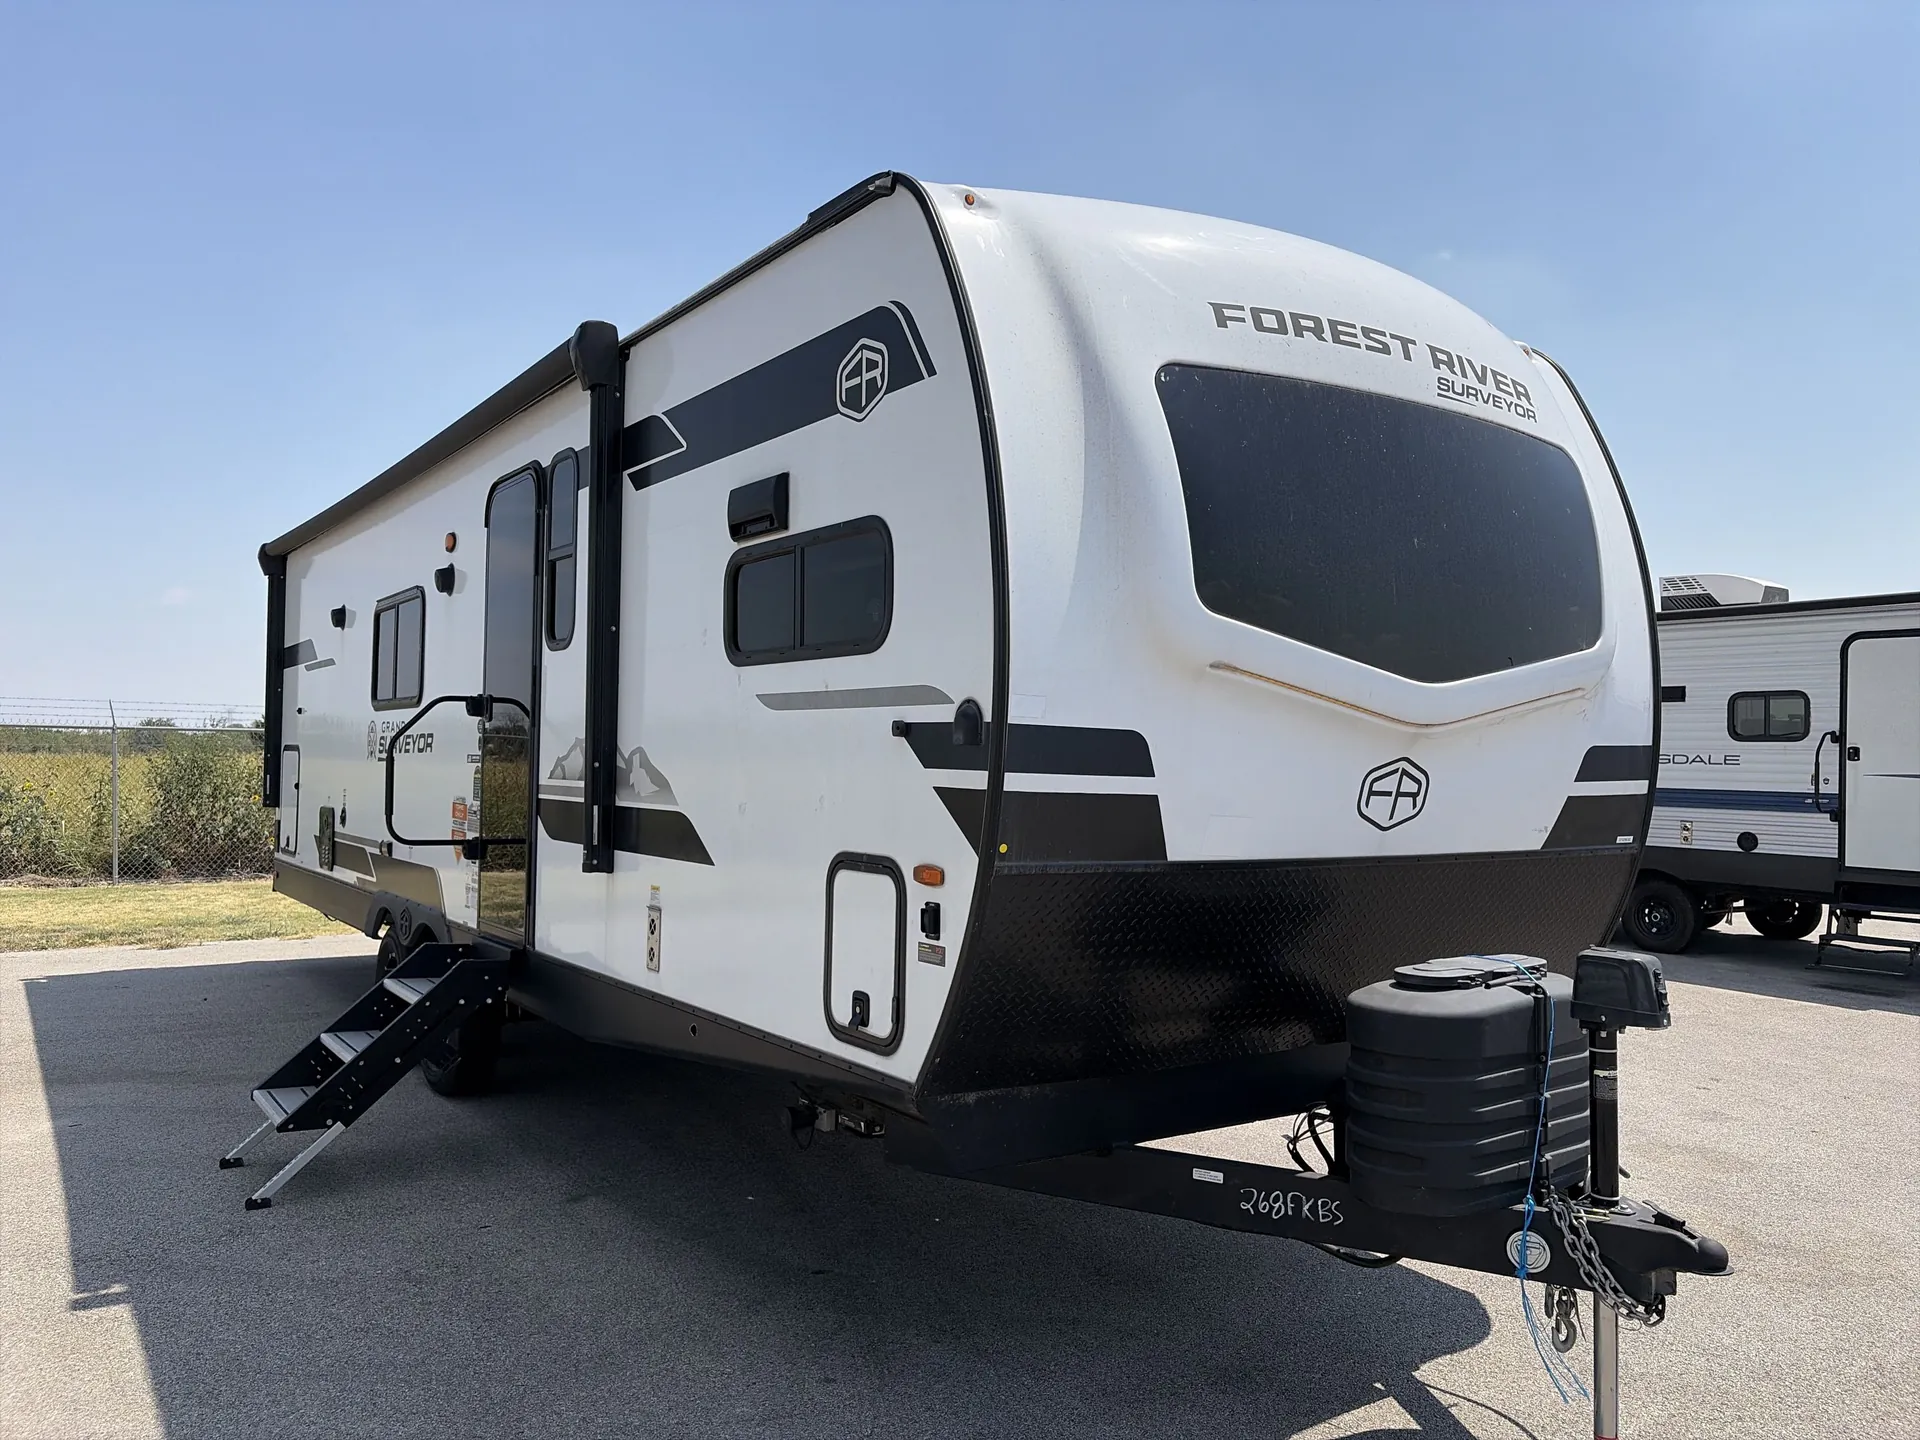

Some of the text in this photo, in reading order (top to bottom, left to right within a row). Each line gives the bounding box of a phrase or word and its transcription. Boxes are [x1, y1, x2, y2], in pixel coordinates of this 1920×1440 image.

[1208, 302, 1534, 408] FOREST RIVER
[1436, 376, 1537, 423] SURVEYOR
[1240, 1188, 1343, 1225] 268FKBS
